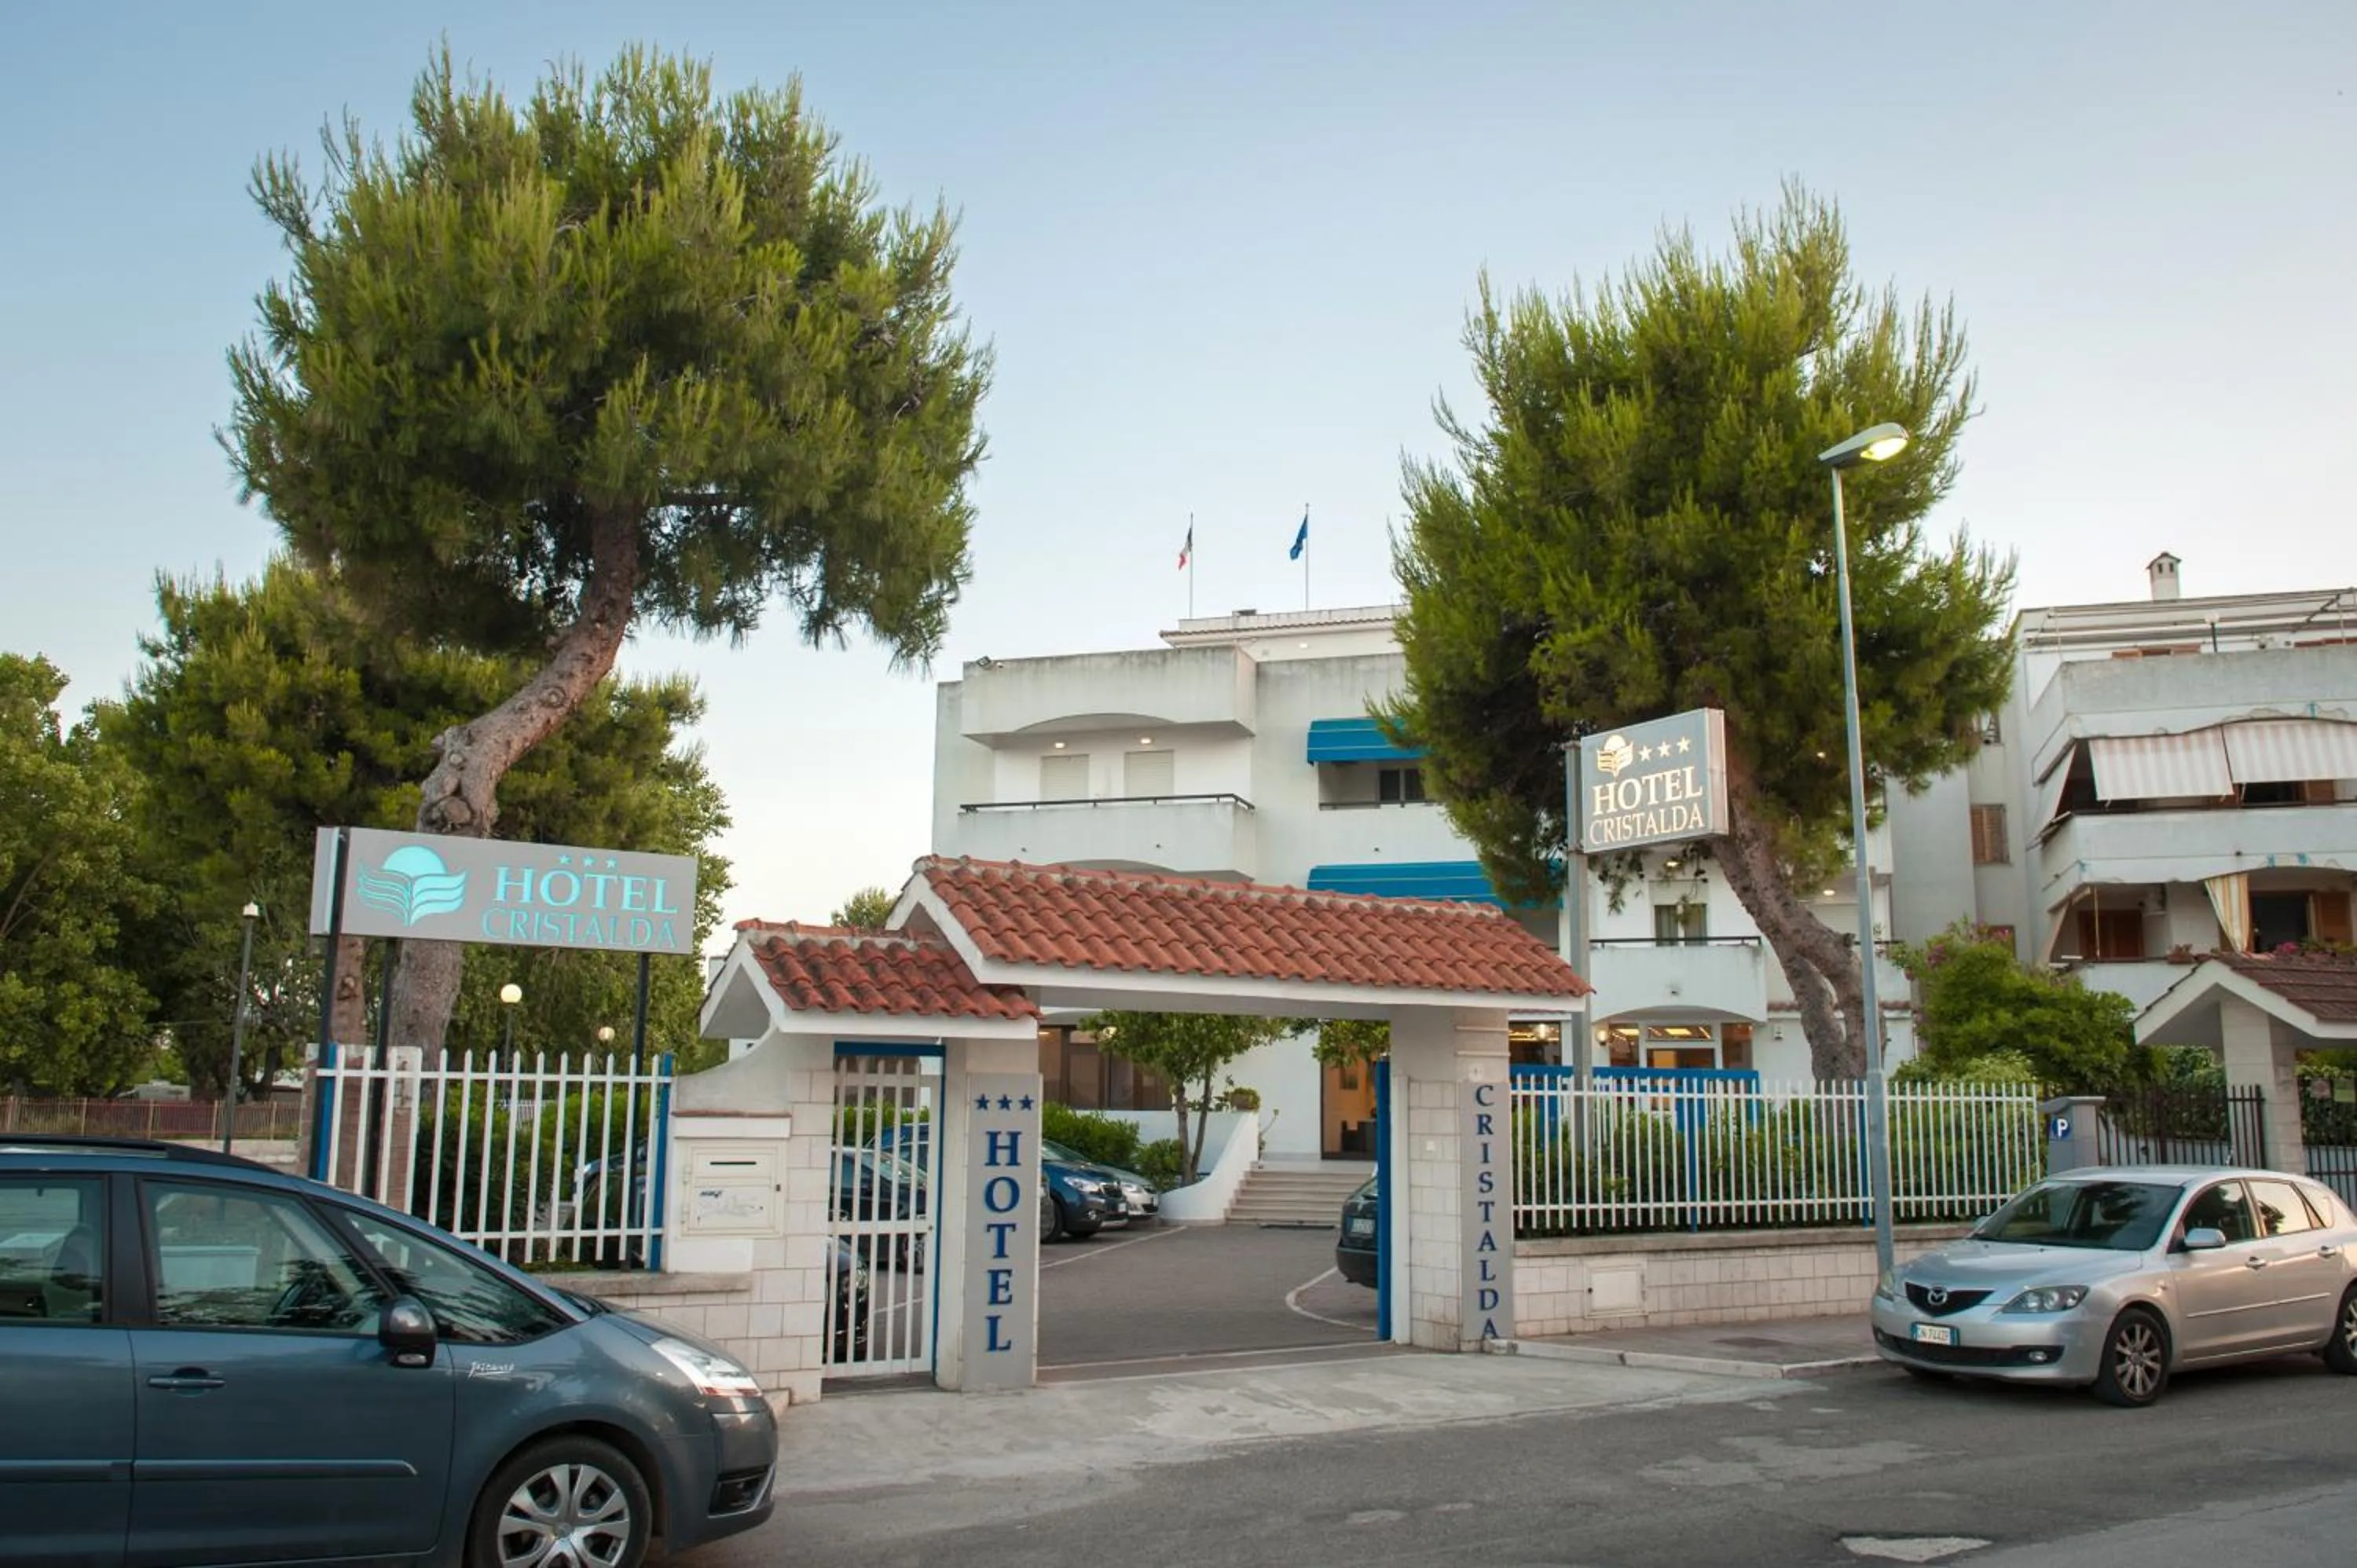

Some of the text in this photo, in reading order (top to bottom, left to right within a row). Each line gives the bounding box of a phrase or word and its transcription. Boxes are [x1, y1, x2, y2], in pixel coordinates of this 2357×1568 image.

[1592, 766, 1703, 815] HOTEL
[1589, 802, 1705, 845] CRISTALDA
[493, 866, 678, 914] HOTEL
[482, 908, 676, 947] CRISTALDA
[2057, 1118, 2069, 1138] P
[1474, 1084, 1500, 1340] CRISTALDA
[984, 1130, 1023, 1353] HOTEL
